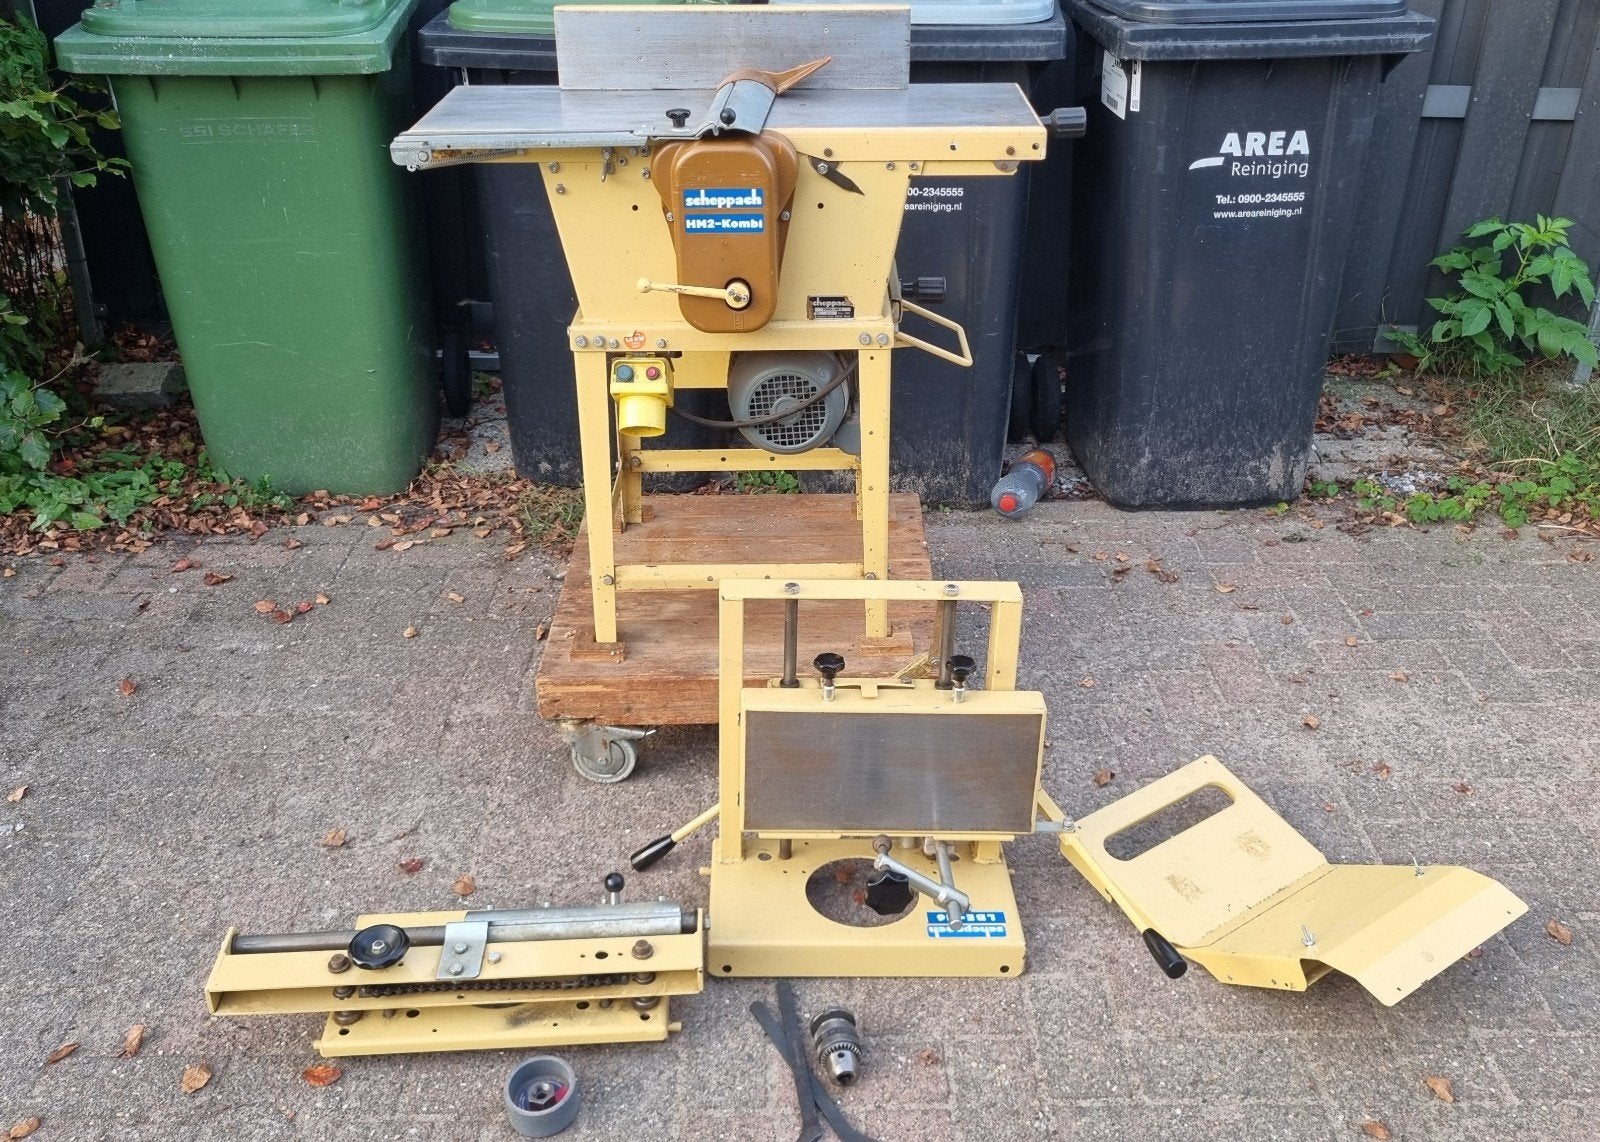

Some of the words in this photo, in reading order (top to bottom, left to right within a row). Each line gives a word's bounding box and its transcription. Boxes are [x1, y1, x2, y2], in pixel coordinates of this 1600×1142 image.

[1219, 130, 1310, 156] AREA
[1231, 160, 1309, 179] Reiniging
[907, 187, 964, 197] 00-2345555
[685, 188, 762, 209] scheppach
[1215, 194, 1236, 205] Tel.:
[1237, 191, 1305, 204] 0900-2345555
[904, 202, 962, 213] eareiniging.nl
[1213, 207, 1302, 218] www.areareiniging.nl
[685, 218, 763, 229] HM2-Kombi
[810, 297, 847, 308] cheppac
